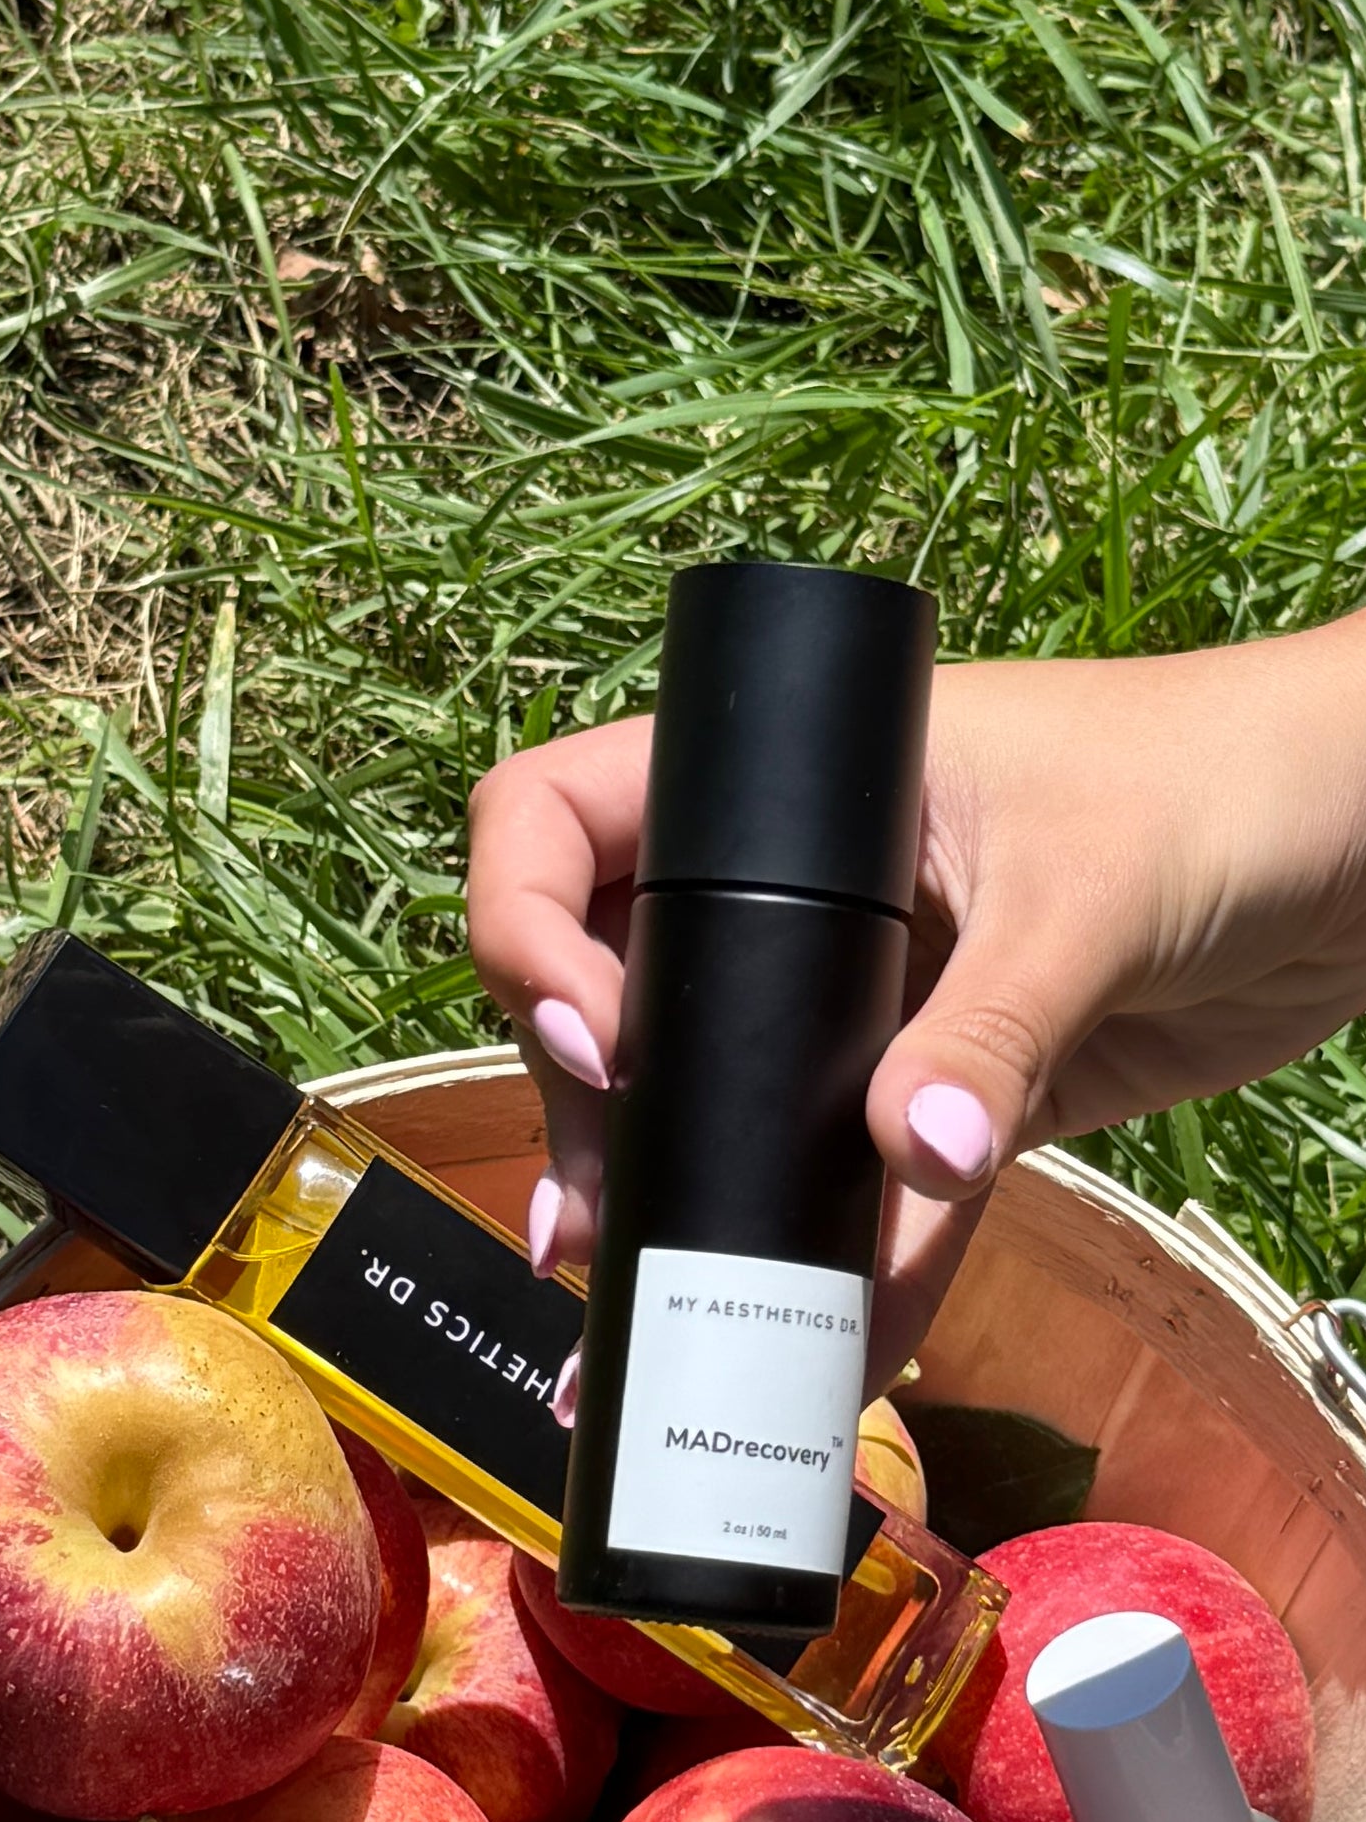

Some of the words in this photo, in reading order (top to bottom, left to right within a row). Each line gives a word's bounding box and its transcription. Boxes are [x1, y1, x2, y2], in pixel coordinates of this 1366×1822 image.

[360, 1248, 416, 1305] DR.
[667, 1294, 698, 1313] MY
[707, 1298, 834, 1331] AESTHETICS
[423, 1300, 554, 1408] HETICS
[722, 1520, 731, 1534] 2
[733, 1524, 747, 1535] oz
